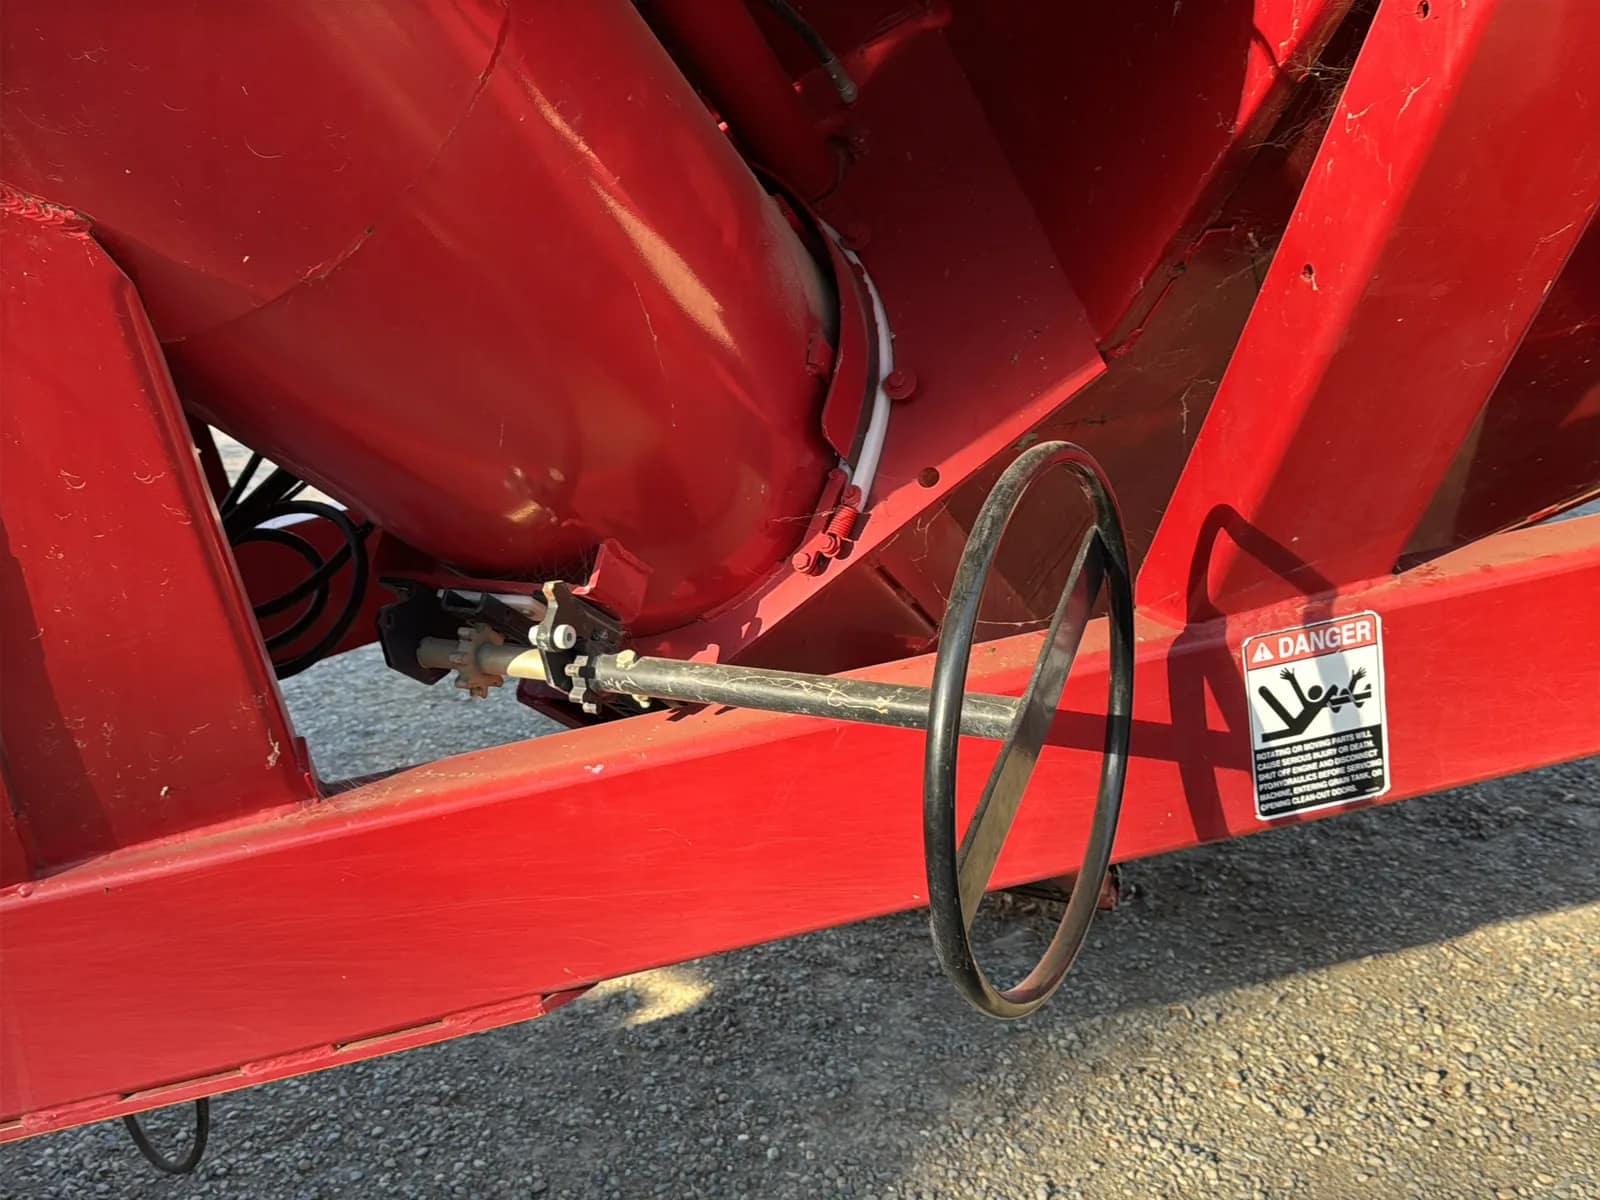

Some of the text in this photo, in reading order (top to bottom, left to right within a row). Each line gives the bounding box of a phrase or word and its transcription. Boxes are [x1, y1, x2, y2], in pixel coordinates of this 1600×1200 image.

[1278, 620, 1372, 658] DANGER
[1256, 731, 1372, 760] ROTATING OR MOVING PARTS WILL
[1257, 760, 1281, 770] CAUSE
[1282, 753, 1312, 766] SERIOUS
[1313, 748, 1337, 759] INJURY
[1258, 749, 1378, 780] SHUT OFF ENGINE AND DISCONNECT
[1318, 766, 1346, 778] BEFORE
[1347, 759, 1382, 772] SERVICING
[1293, 781, 1328, 794] ENTERING
[1328, 778, 1350, 786] GRAIN
[1372, 769, 1382, 777] OR
[1260, 799, 1291, 811] OPENING
